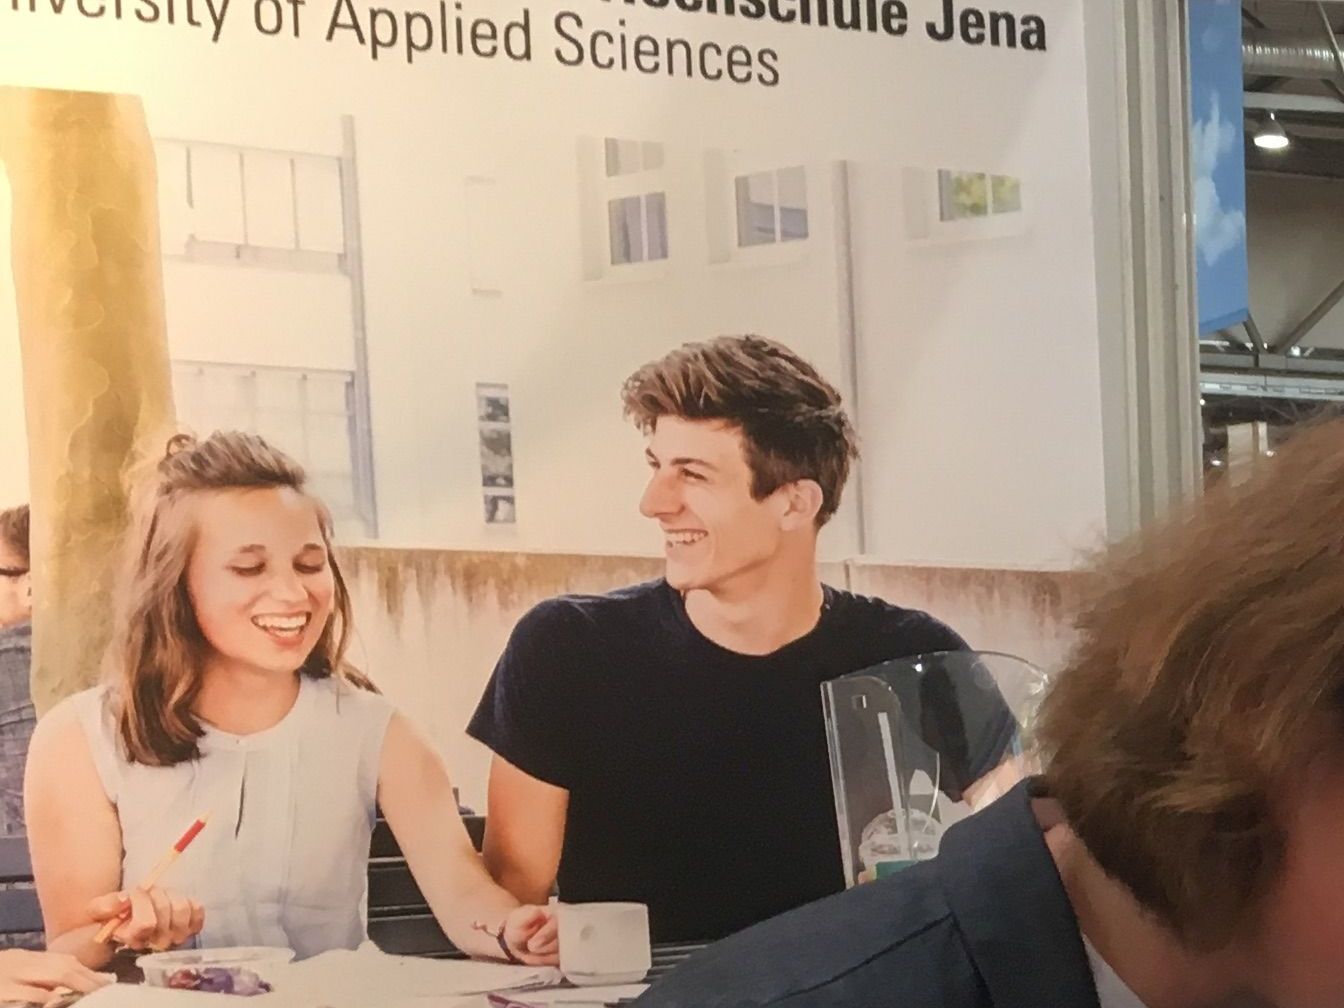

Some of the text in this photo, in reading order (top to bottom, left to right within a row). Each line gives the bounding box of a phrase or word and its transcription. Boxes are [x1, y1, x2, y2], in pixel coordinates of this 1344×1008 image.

[254, 0, 300, 37] of
[325, 0, 532, 63] Applied
[554, 10, 780, 87] Sciences
[926, 0, 1047, 51] Jena
